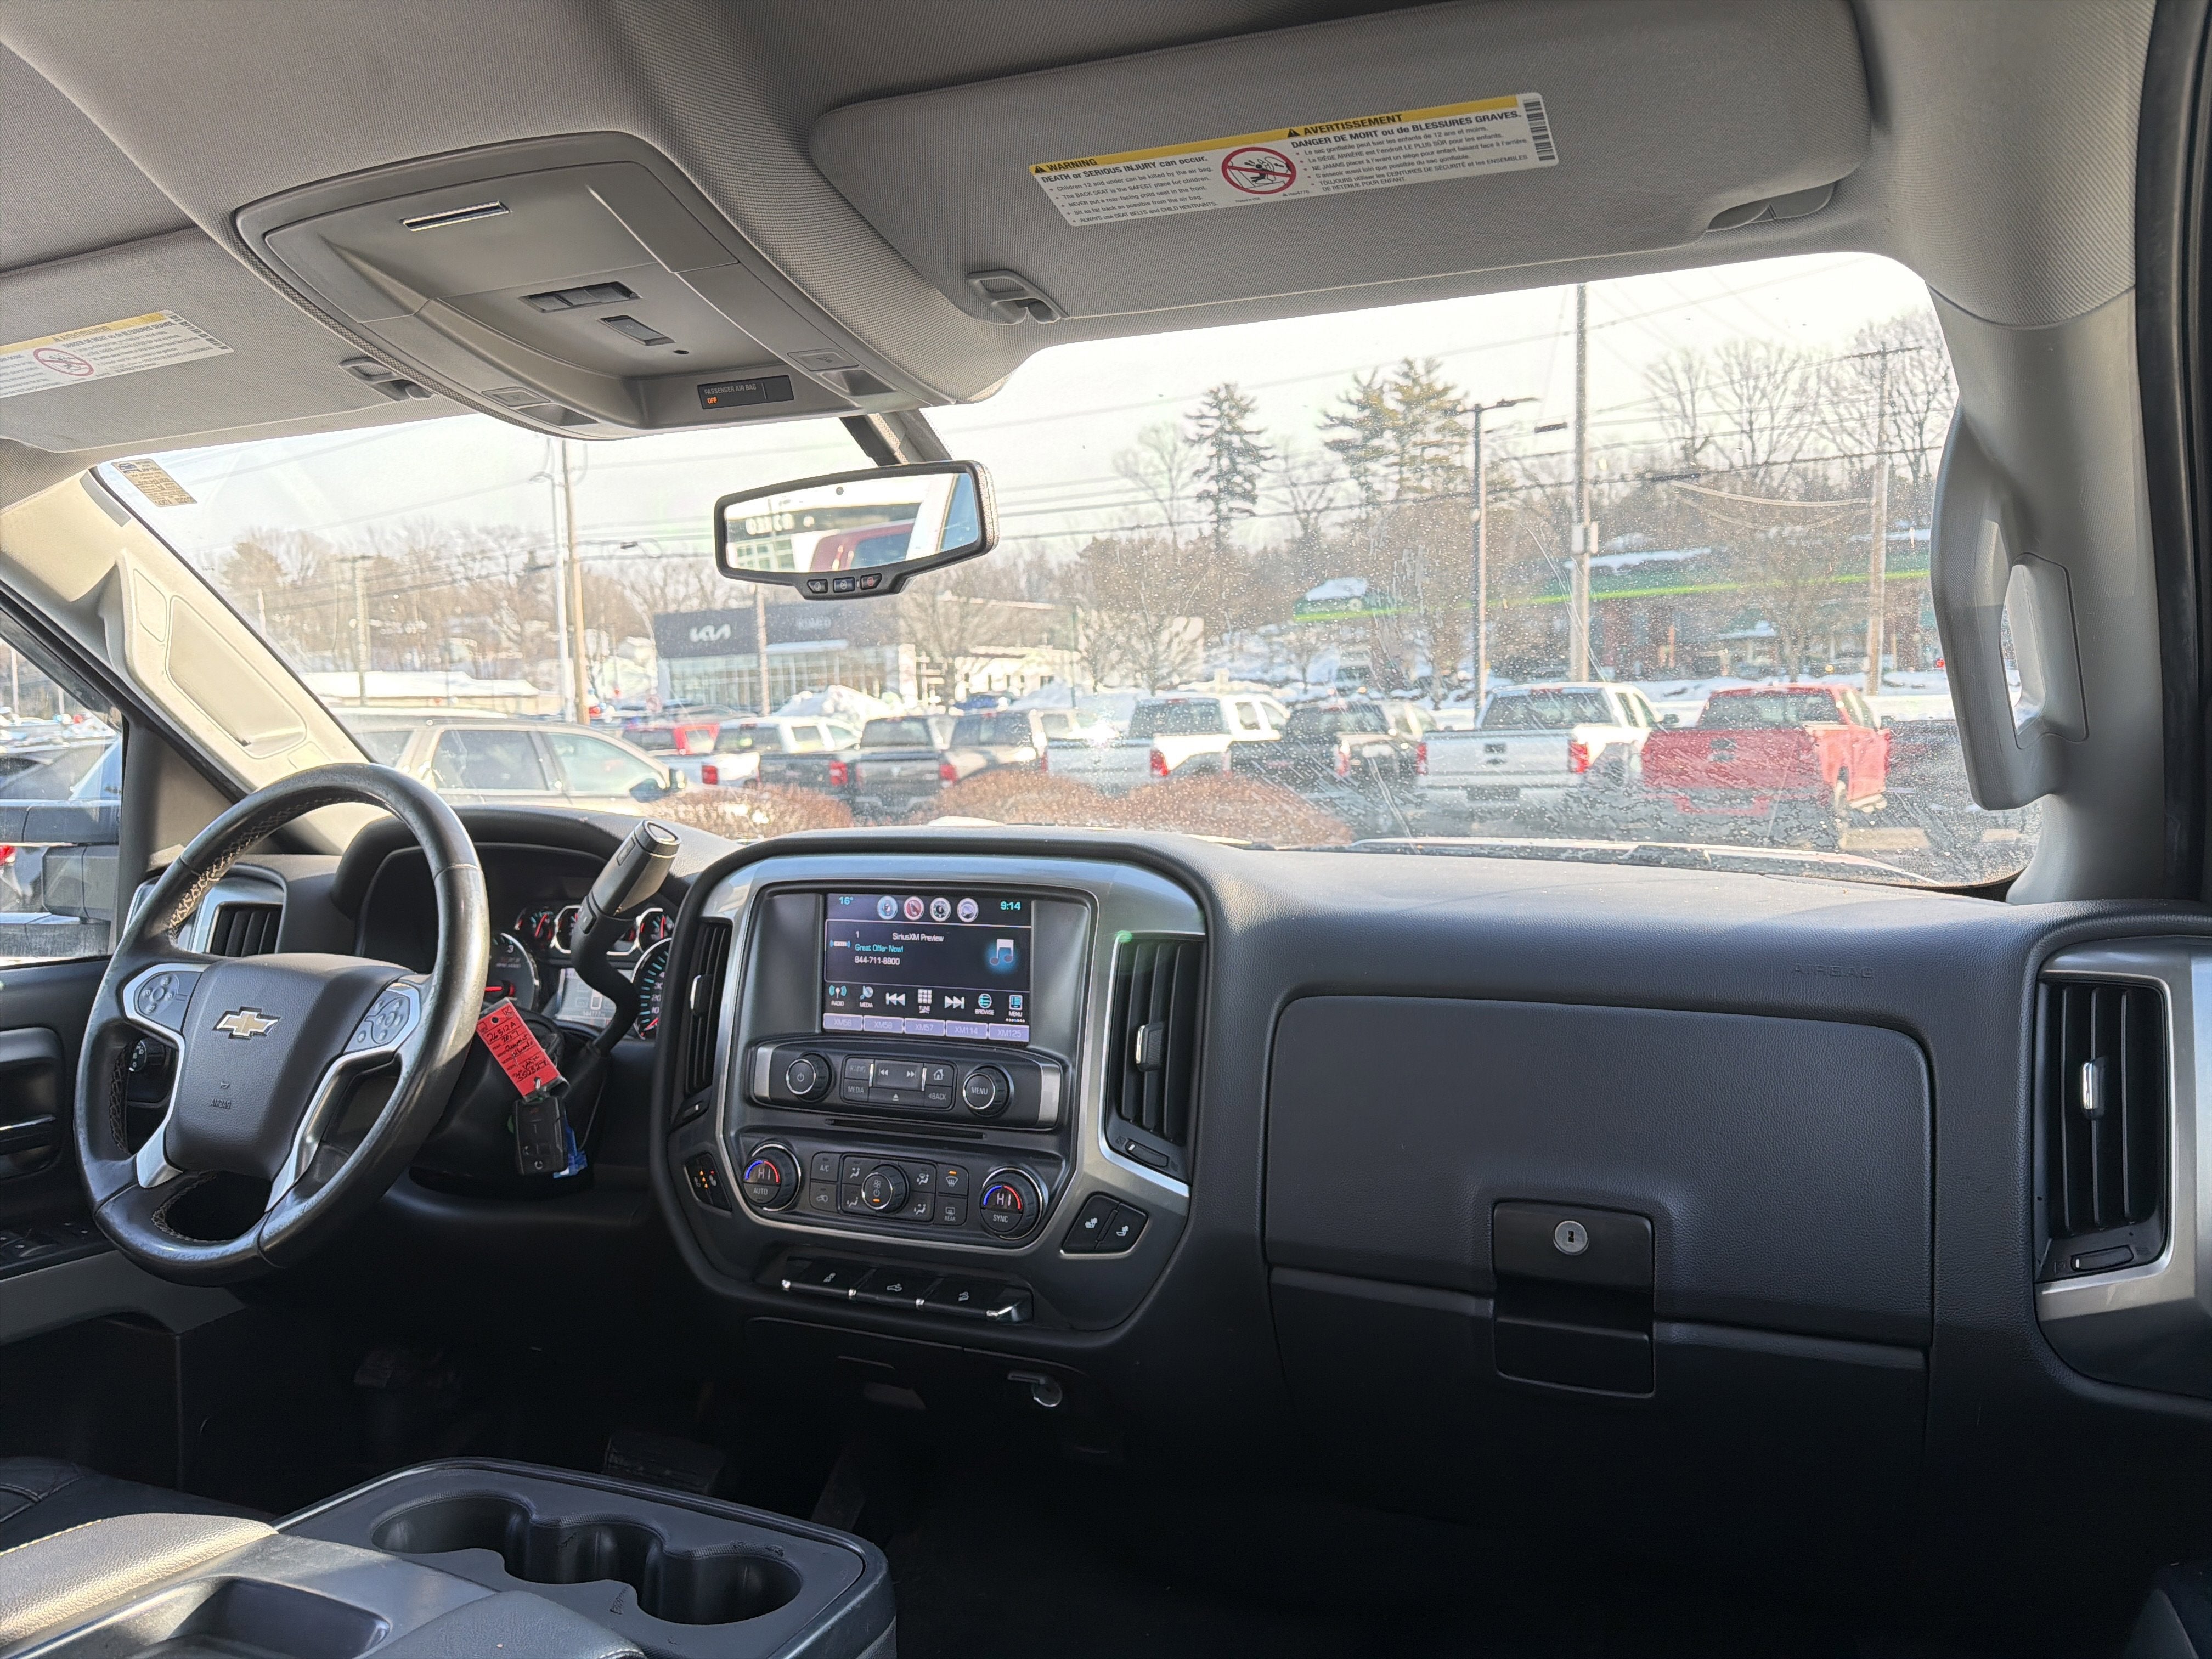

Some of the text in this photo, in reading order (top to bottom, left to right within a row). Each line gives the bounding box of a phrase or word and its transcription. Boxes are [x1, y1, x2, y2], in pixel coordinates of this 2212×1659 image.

[1291, 138, 1332, 148] DANGER
[1350, 130, 1379, 140] MORT
[1411, 117, 1472, 132] BLESSURES
[1475, 111, 1521, 123] GRAVES.
[1304, 114, 1403, 136] AVERTISSEMENT
[1338, 150, 1364, 159] ARRIÈRE
[1041, 174, 1071, 183] DEATH
[1083, 167, 1122, 177] SERIOUS
[1124, 162, 1155, 172] INJURY
[1179, 156, 1207, 164] occur.
[1047, 159, 1097, 171] WARNING
[1389, 161, 1415, 170] possible
[1319, 177, 1353, 186] TOUJOURS
[1386, 168, 1422, 177] CEINTURES
[1105, 193, 1139, 202] rear-facing
[704, 386, 735, 394] PASSENGER
[839, 896, 854, 905] 16°
[1000, 901, 1021, 910] 9:14
[921, 934, 944, 942] Preview
[855, 956, 900, 965] 844-711-8800
[997, 1029, 1022, 1037] XM125
[932, 1092, 946, 1101] BACK
[210, 1098, 231, 1109] AIRBAG
[993, 1214, 1008, 1223] SYNC
